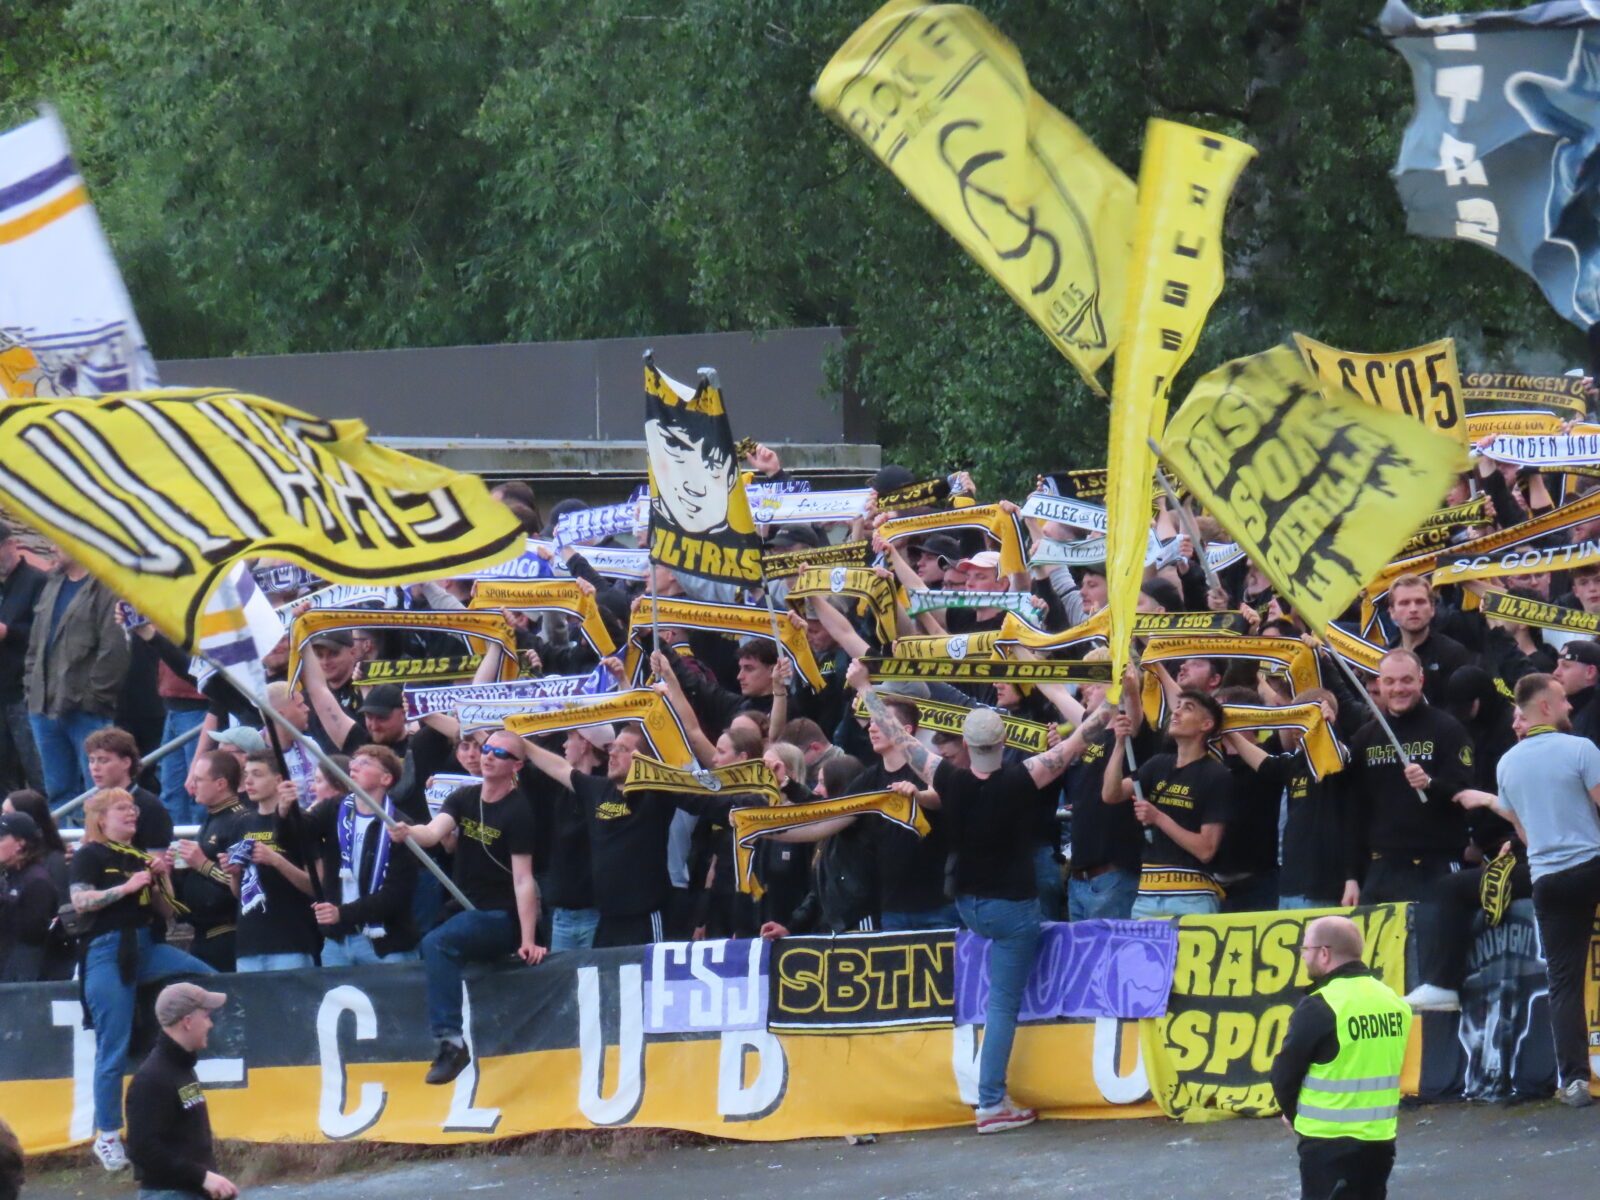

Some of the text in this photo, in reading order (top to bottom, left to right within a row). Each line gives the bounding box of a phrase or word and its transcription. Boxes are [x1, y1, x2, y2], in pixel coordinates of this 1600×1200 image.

[1034, 501, 1078, 524] ALLEZ
[652, 527, 763, 581] ULTRAS
[1451, 556, 1491, 574] SC
[1497, 597, 1559, 623] ULTRAS
[367, 658, 450, 678] ULTRAS
[880, 660, 1070, 678] ULTRAS 1905
[1365, 741, 1434, 760] ULTRAS
[777, 941, 956, 1014] SBTN
[1348, 1011, 1403, 1042] ORDNER
